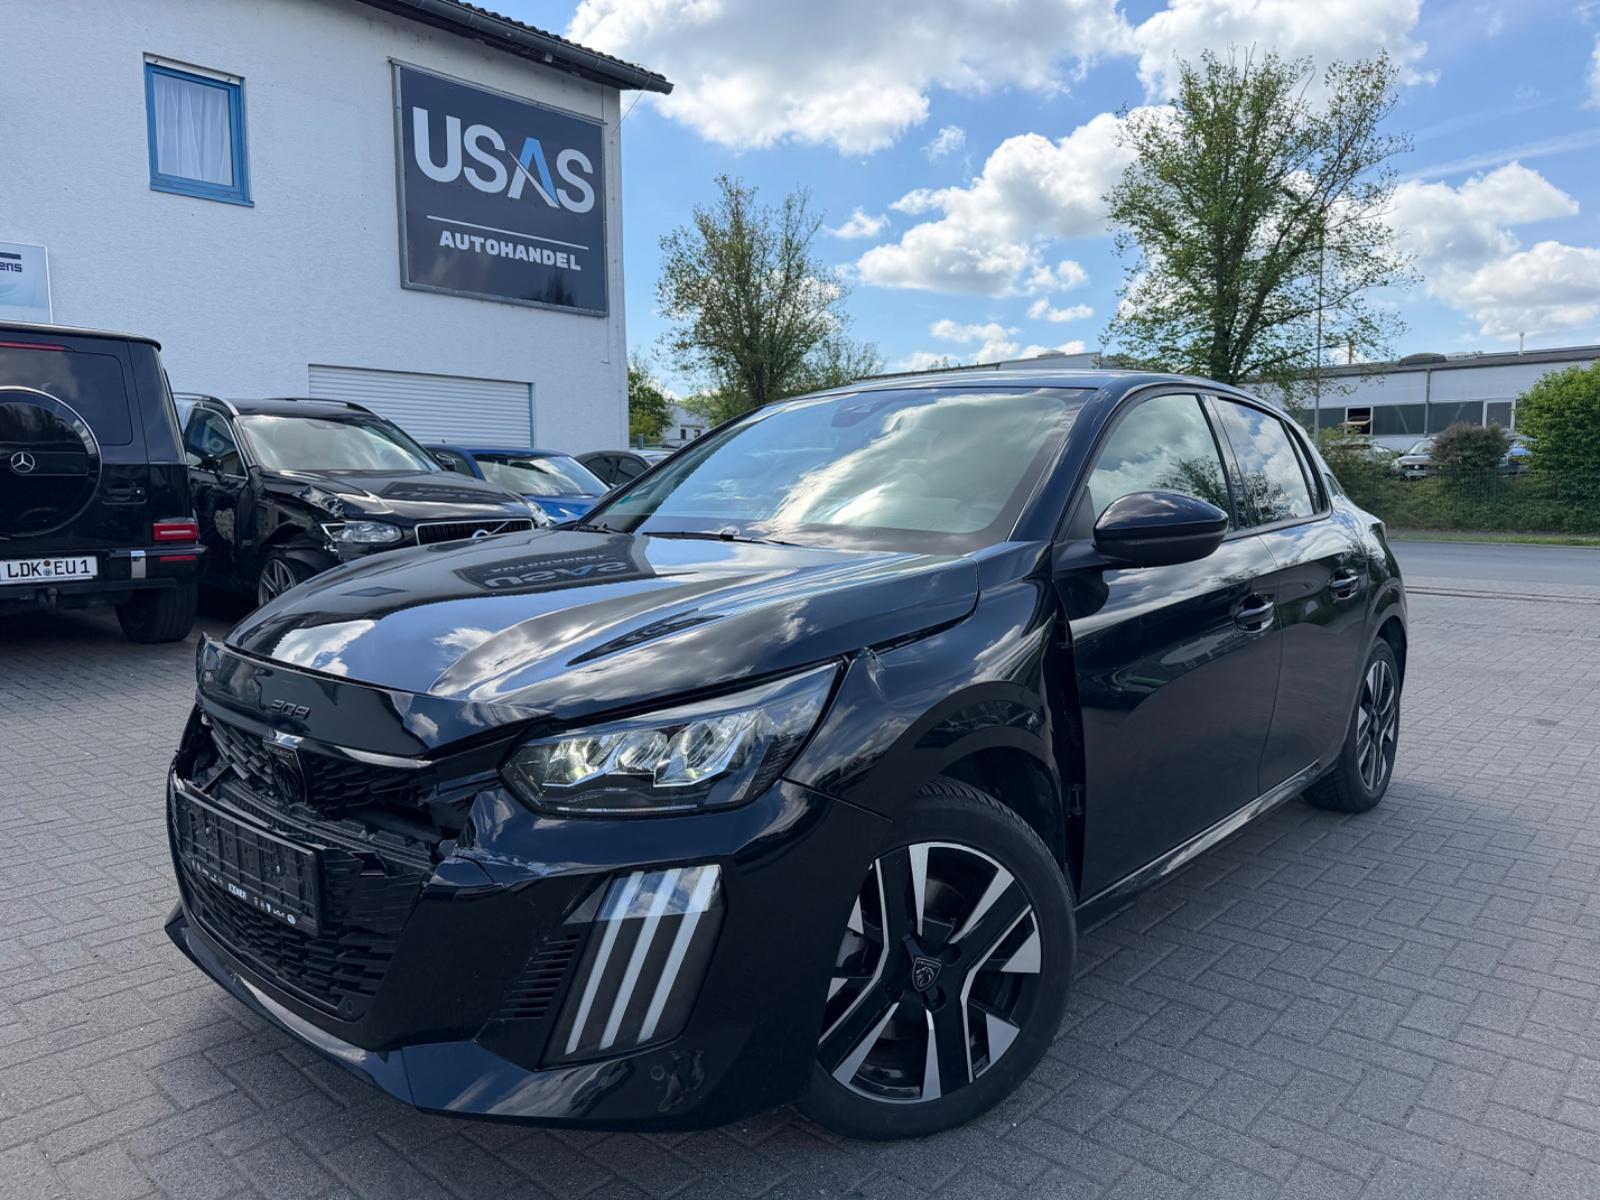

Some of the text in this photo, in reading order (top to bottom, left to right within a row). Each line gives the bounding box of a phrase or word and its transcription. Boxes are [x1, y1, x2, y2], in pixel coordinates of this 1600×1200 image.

[412, 106, 595, 213] USAS
[439, 230, 582, 271] AUTOHANDEL
[7, 562, 42, 578] LDK
